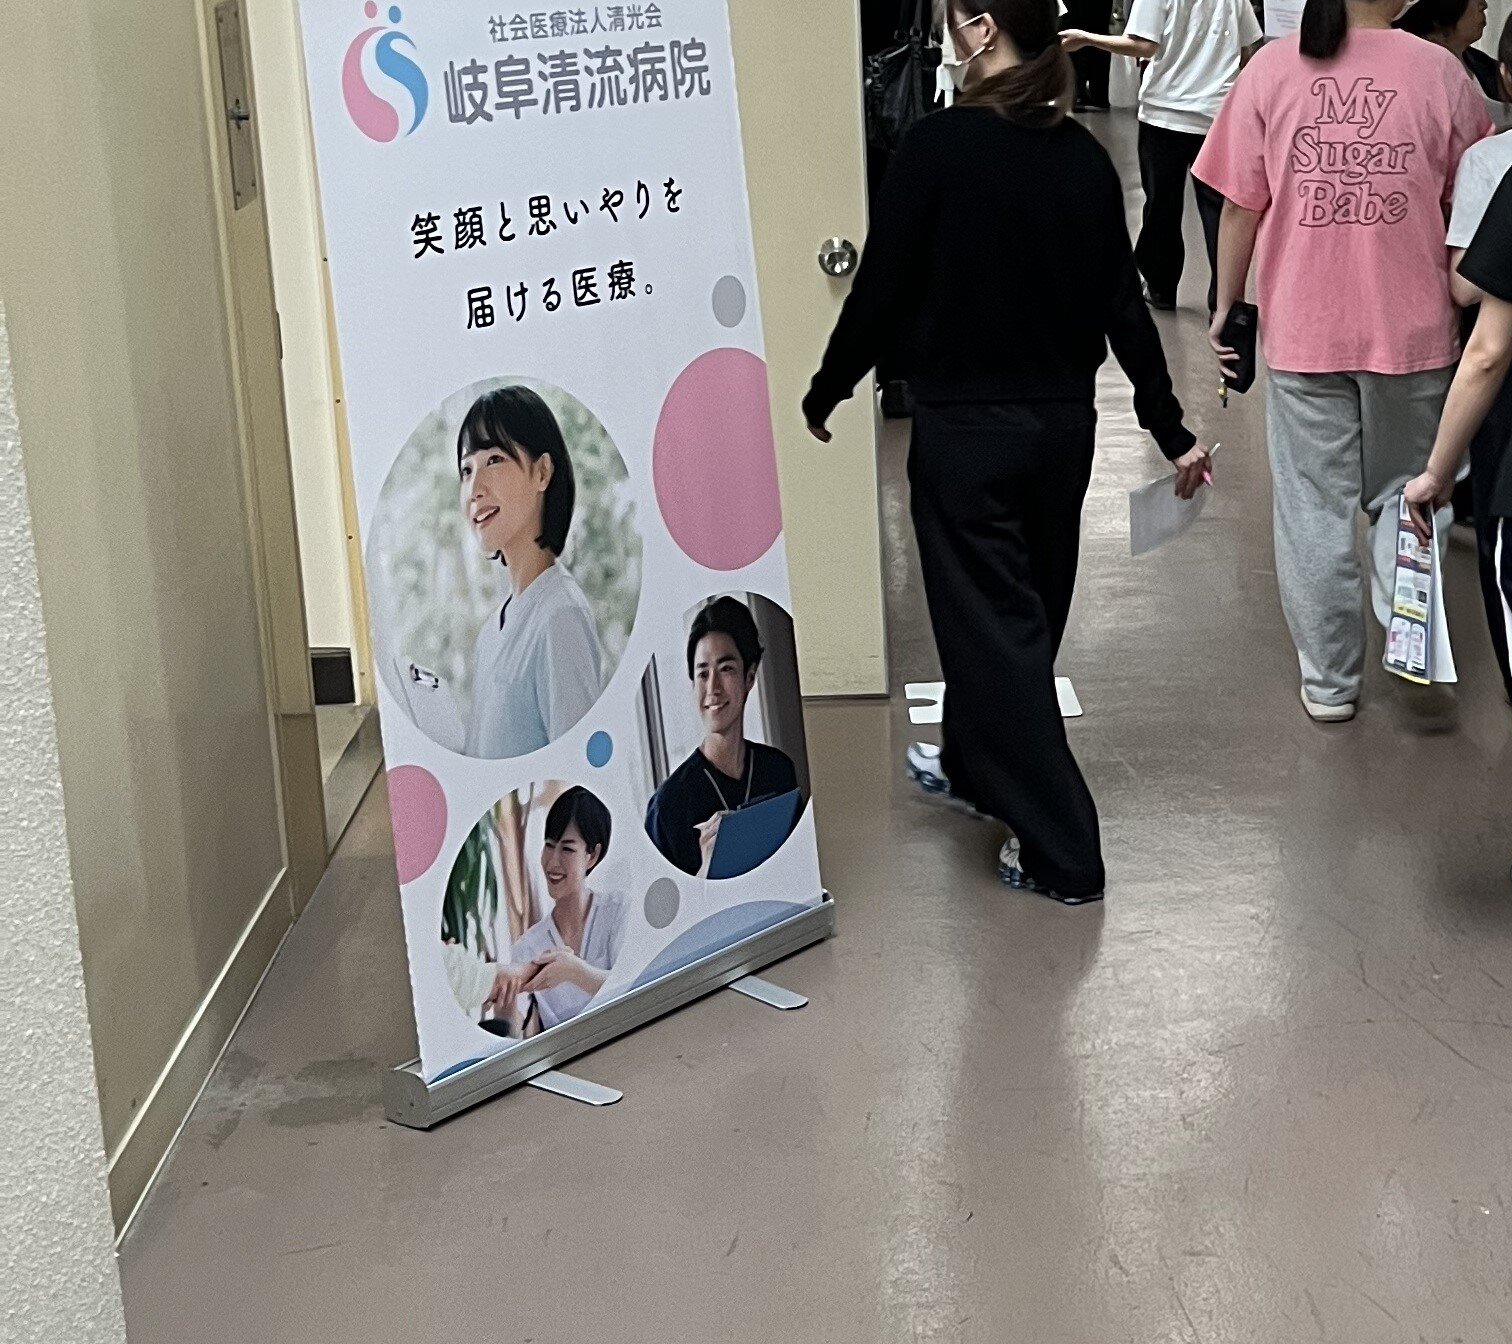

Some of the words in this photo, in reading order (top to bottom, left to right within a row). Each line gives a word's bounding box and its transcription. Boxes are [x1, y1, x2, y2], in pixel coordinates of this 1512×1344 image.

[487, 2, 664, 43] 社会医療法人清光会
[443, 37, 711, 126] 岐阜清流病院
[1311, 77, 1398, 139] My
[1291, 125, 1416, 186] Sugar
[410, 176, 683, 259] 笑顔と思いやりを
[1298, 179, 1409, 228] Babe
[466, 259, 654, 330] 届ける医療。
